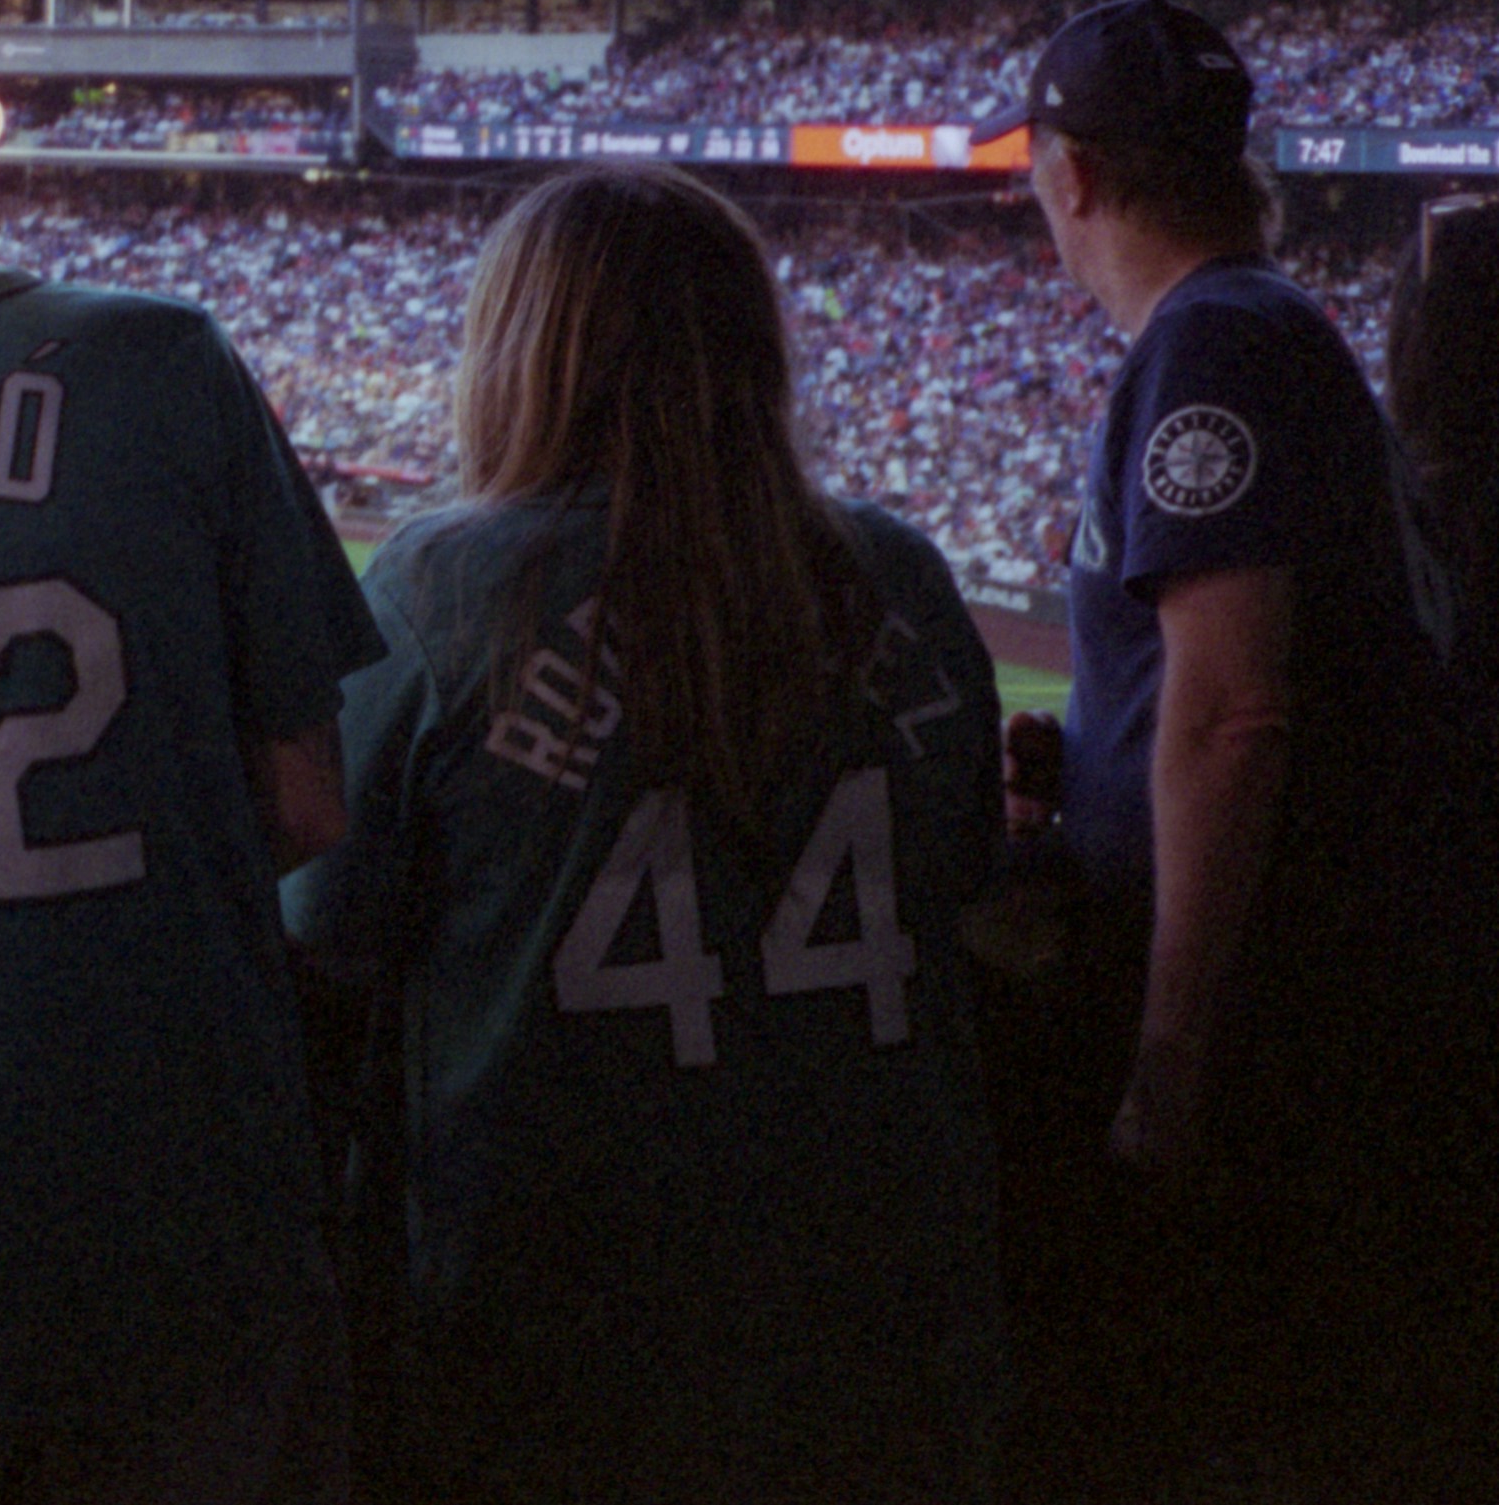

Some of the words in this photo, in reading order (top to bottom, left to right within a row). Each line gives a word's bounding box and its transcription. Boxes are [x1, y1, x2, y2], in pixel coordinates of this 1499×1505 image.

[841, 126, 925, 166] Optum
[1298, 137, 1346, 165] 7:47
[1398, 141, 1465, 165] Download
[551, 764, 917, 1068] 44
